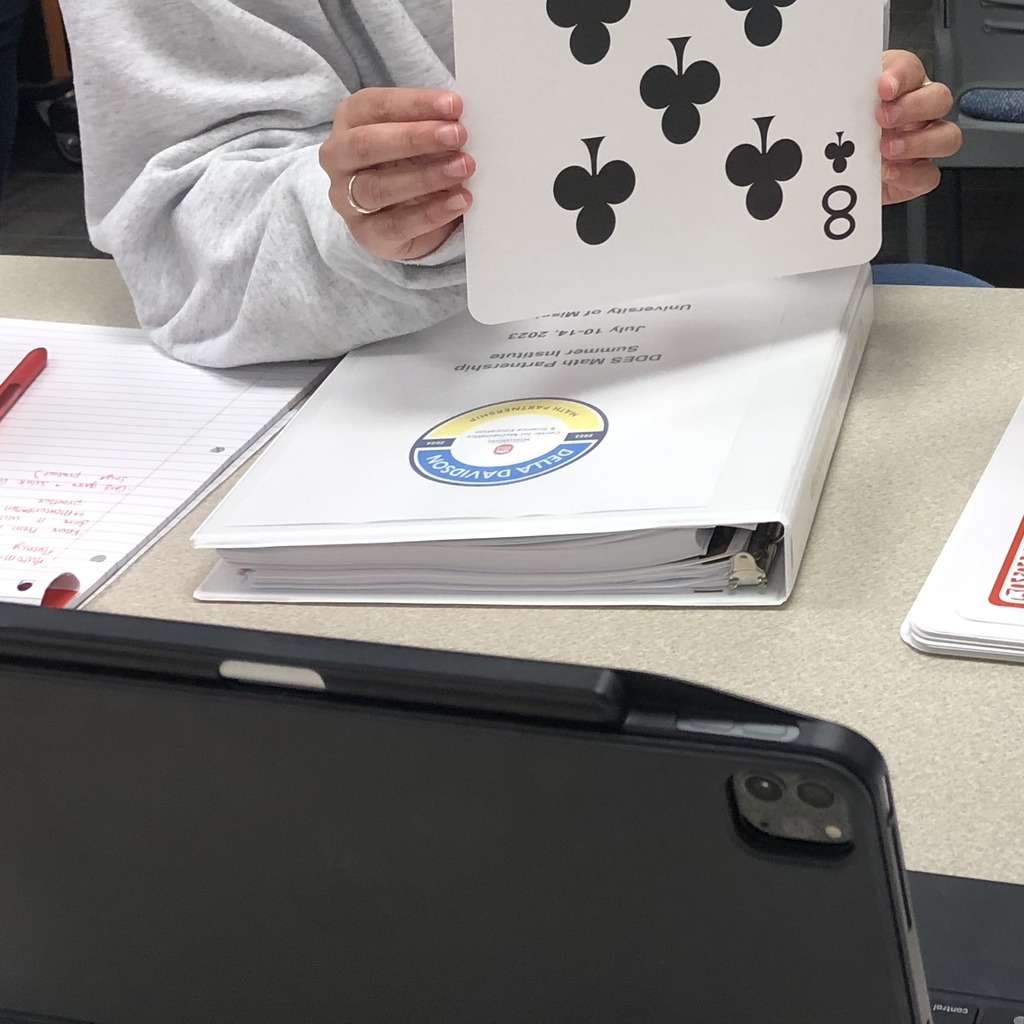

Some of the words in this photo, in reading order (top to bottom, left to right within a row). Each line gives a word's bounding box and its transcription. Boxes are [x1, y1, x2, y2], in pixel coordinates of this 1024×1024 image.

[820, 184, 860, 242] 8
[606, 303, 692, 317] University
[508, 330, 550, 341] 2023
[555, 326, 603, 338] 10-14,
[609, 324, 646, 336] July
[489, 350, 561, 362] Institute
[564, 344, 640, 357] Summer
[563, 356, 606, 367] Math
[611, 353, 663, 365] DDES
[453, 359, 558, 374] Partnership
[468, 405, 551, 423] PARTNERSHIP
[552, 406, 580, 419] MATH
[425, 453, 513, 480] DAVIDSON
[514, 447, 575, 475] DELLA
[932, 1004, 969, 1015] control
